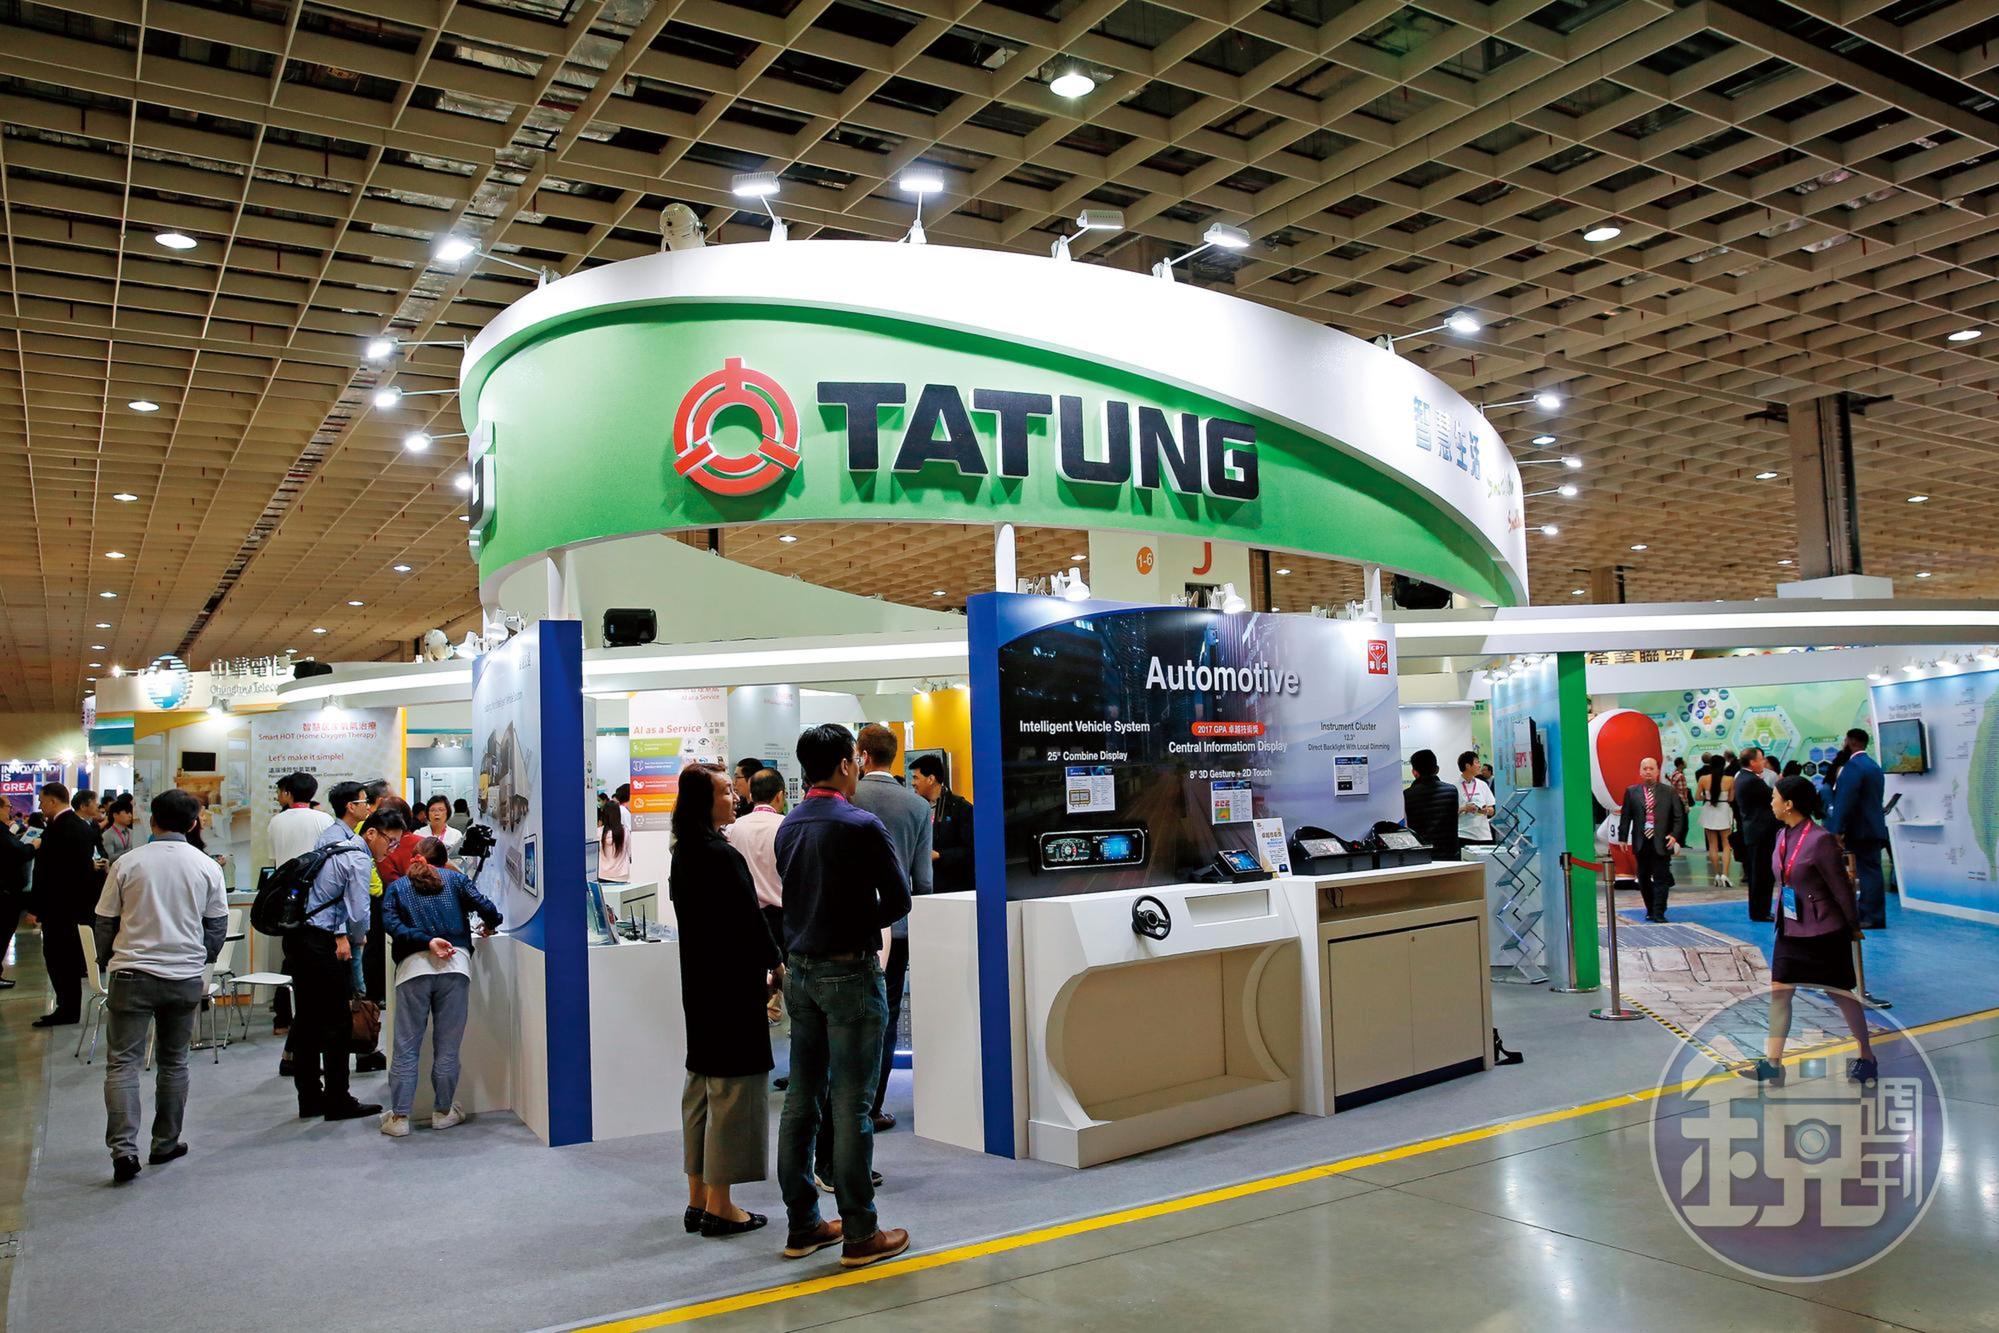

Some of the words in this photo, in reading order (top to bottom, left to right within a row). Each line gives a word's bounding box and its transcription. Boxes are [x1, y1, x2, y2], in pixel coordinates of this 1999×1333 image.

[817, 381, 1260, 501] TATUNG
[1138, 552, 1153, 568] 1-6
[1192, 541, 1212, 576] J
[1145, 656, 1300, 694] Automotive
[254, 681, 280, 693] Teleco
[633, 726, 643, 734] AI
[666, 724, 702, 733] Service
[1019, 720, 1073, 735] Intelligent
[1075, 720, 1112, 733] Vehicle
[1114, 720, 1151, 734] System
[1197, 725, 1212, 734] 2017
[1214, 725, 1227, 734] GPA
[1320, 721, 1354, 731] Instrument
[1355, 721, 1377, 731] Cluster
[258, 733, 279, 741] Smart
[280, 732, 295, 740] HOT
[1168, 741, 1202, 753] Central
[1257, 740, 1288, 754] Display
[1307, 743, 1322, 751] Direct
[1323, 743, 1345, 752] Backlight
[1346, 743, 1357, 751] With
[1357, 743, 1369, 751] Local
[1370, 743, 1391, 752] Dimming
[268, 753, 286, 762] Let's
[287, 753, 309, 761] make
[309, 753, 315, 761] it
[316, 753, 344, 762] simple!
[1063, 751, 1099, 761] Combine
[1099, 750, 1128, 762] Display
[1, 773, 12, 782] IS
[1198, 769, 1209, 779] 3D
[1209, 769, 1236, 779] Gesture
[1242, 768, 1252, 778] 2D
[1253, 767, 1272, 777] Touch
[3, 782, 34, 792] GREA
